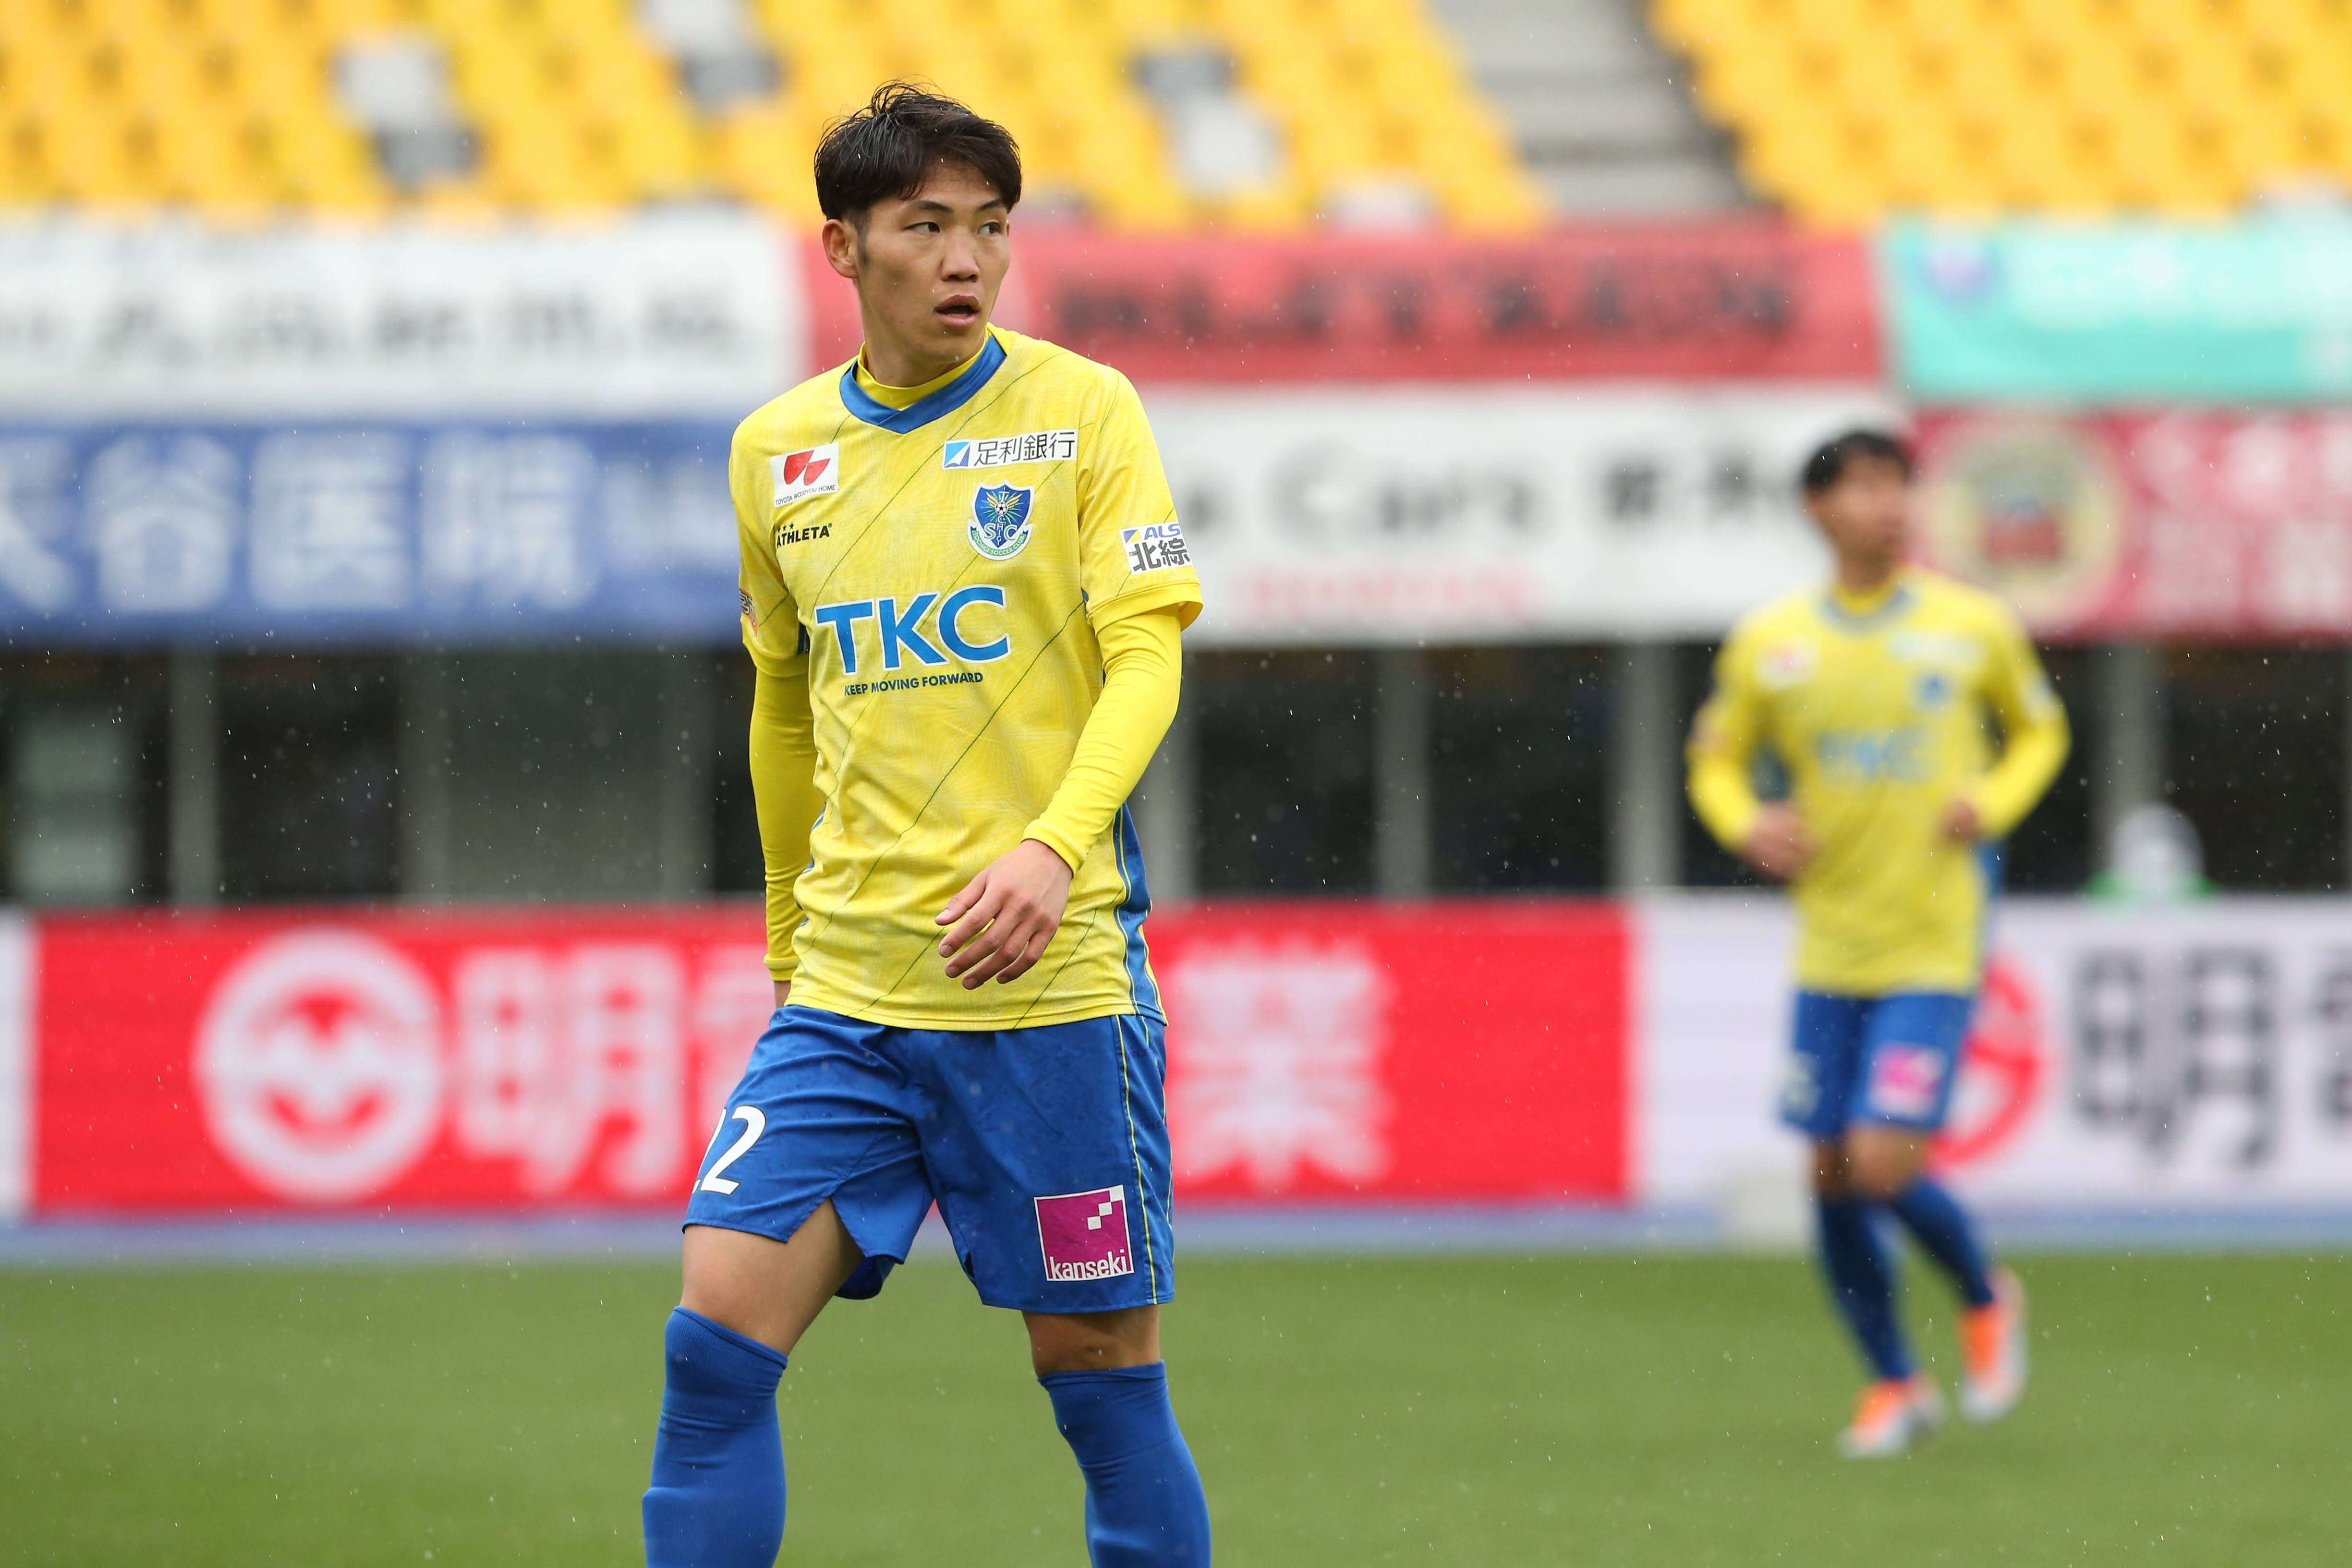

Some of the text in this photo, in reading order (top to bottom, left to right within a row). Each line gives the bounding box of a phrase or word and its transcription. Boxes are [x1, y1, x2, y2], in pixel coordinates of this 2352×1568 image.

[974, 432, 1076, 467] 足利銀行
[775, 496, 793, 505] TOYOTA
[973, 531, 1025, 556] TOCHIGI SOCCER CLUB
[1144, 523, 1181, 540] ALS
[815, 585, 1010, 674] TKC
[845, 672, 983, 695] KEEP MOVING FORWARD
[1049, 1248, 1128, 1280] kanseki
